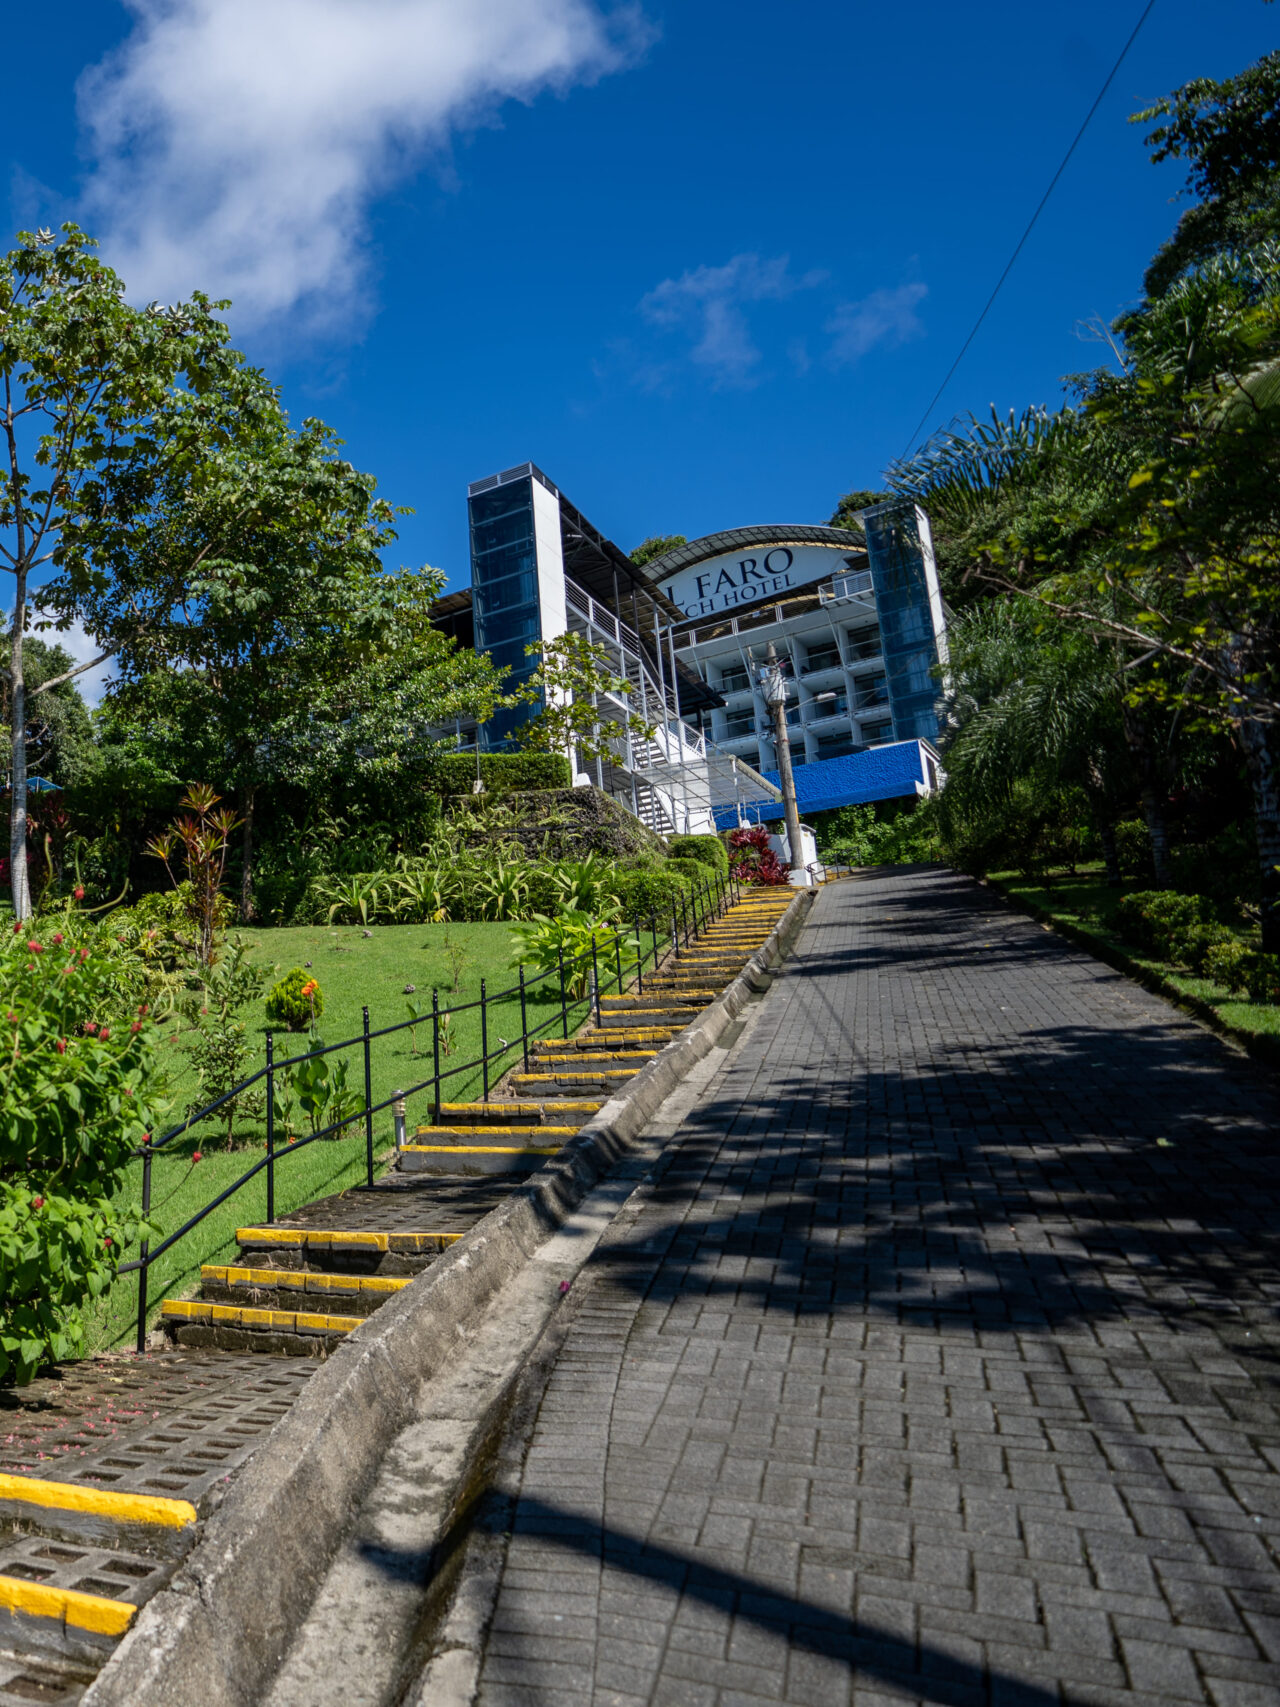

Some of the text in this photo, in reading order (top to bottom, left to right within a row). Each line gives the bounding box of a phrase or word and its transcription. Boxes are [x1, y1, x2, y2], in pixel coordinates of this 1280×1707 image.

[665, 547, 794, 607] L FARO
[723, 574, 796, 606] HOTEL
